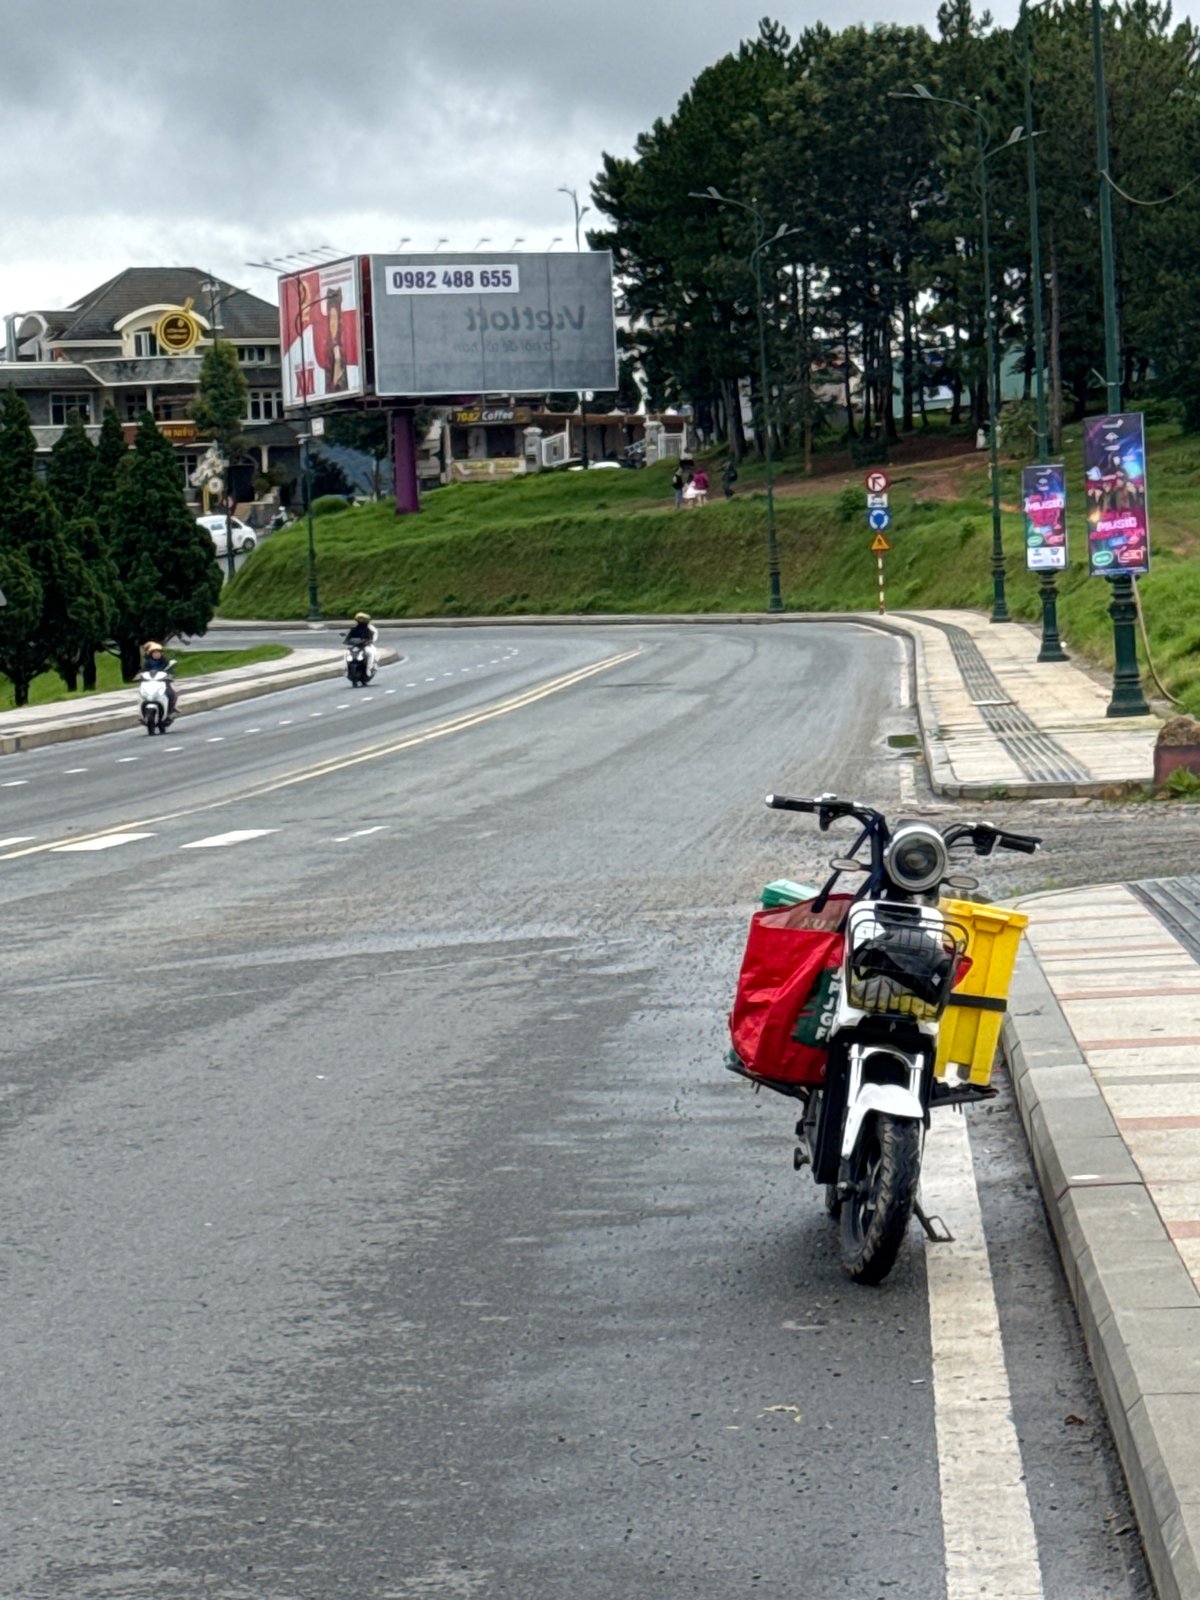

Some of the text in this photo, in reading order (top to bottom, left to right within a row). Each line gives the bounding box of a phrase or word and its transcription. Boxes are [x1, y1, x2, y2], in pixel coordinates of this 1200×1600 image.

[392, 269, 513, 289] 0982 488 655
[482, 409, 514, 421] Coffee
[1096, 516, 1138, 533] MUSIC
